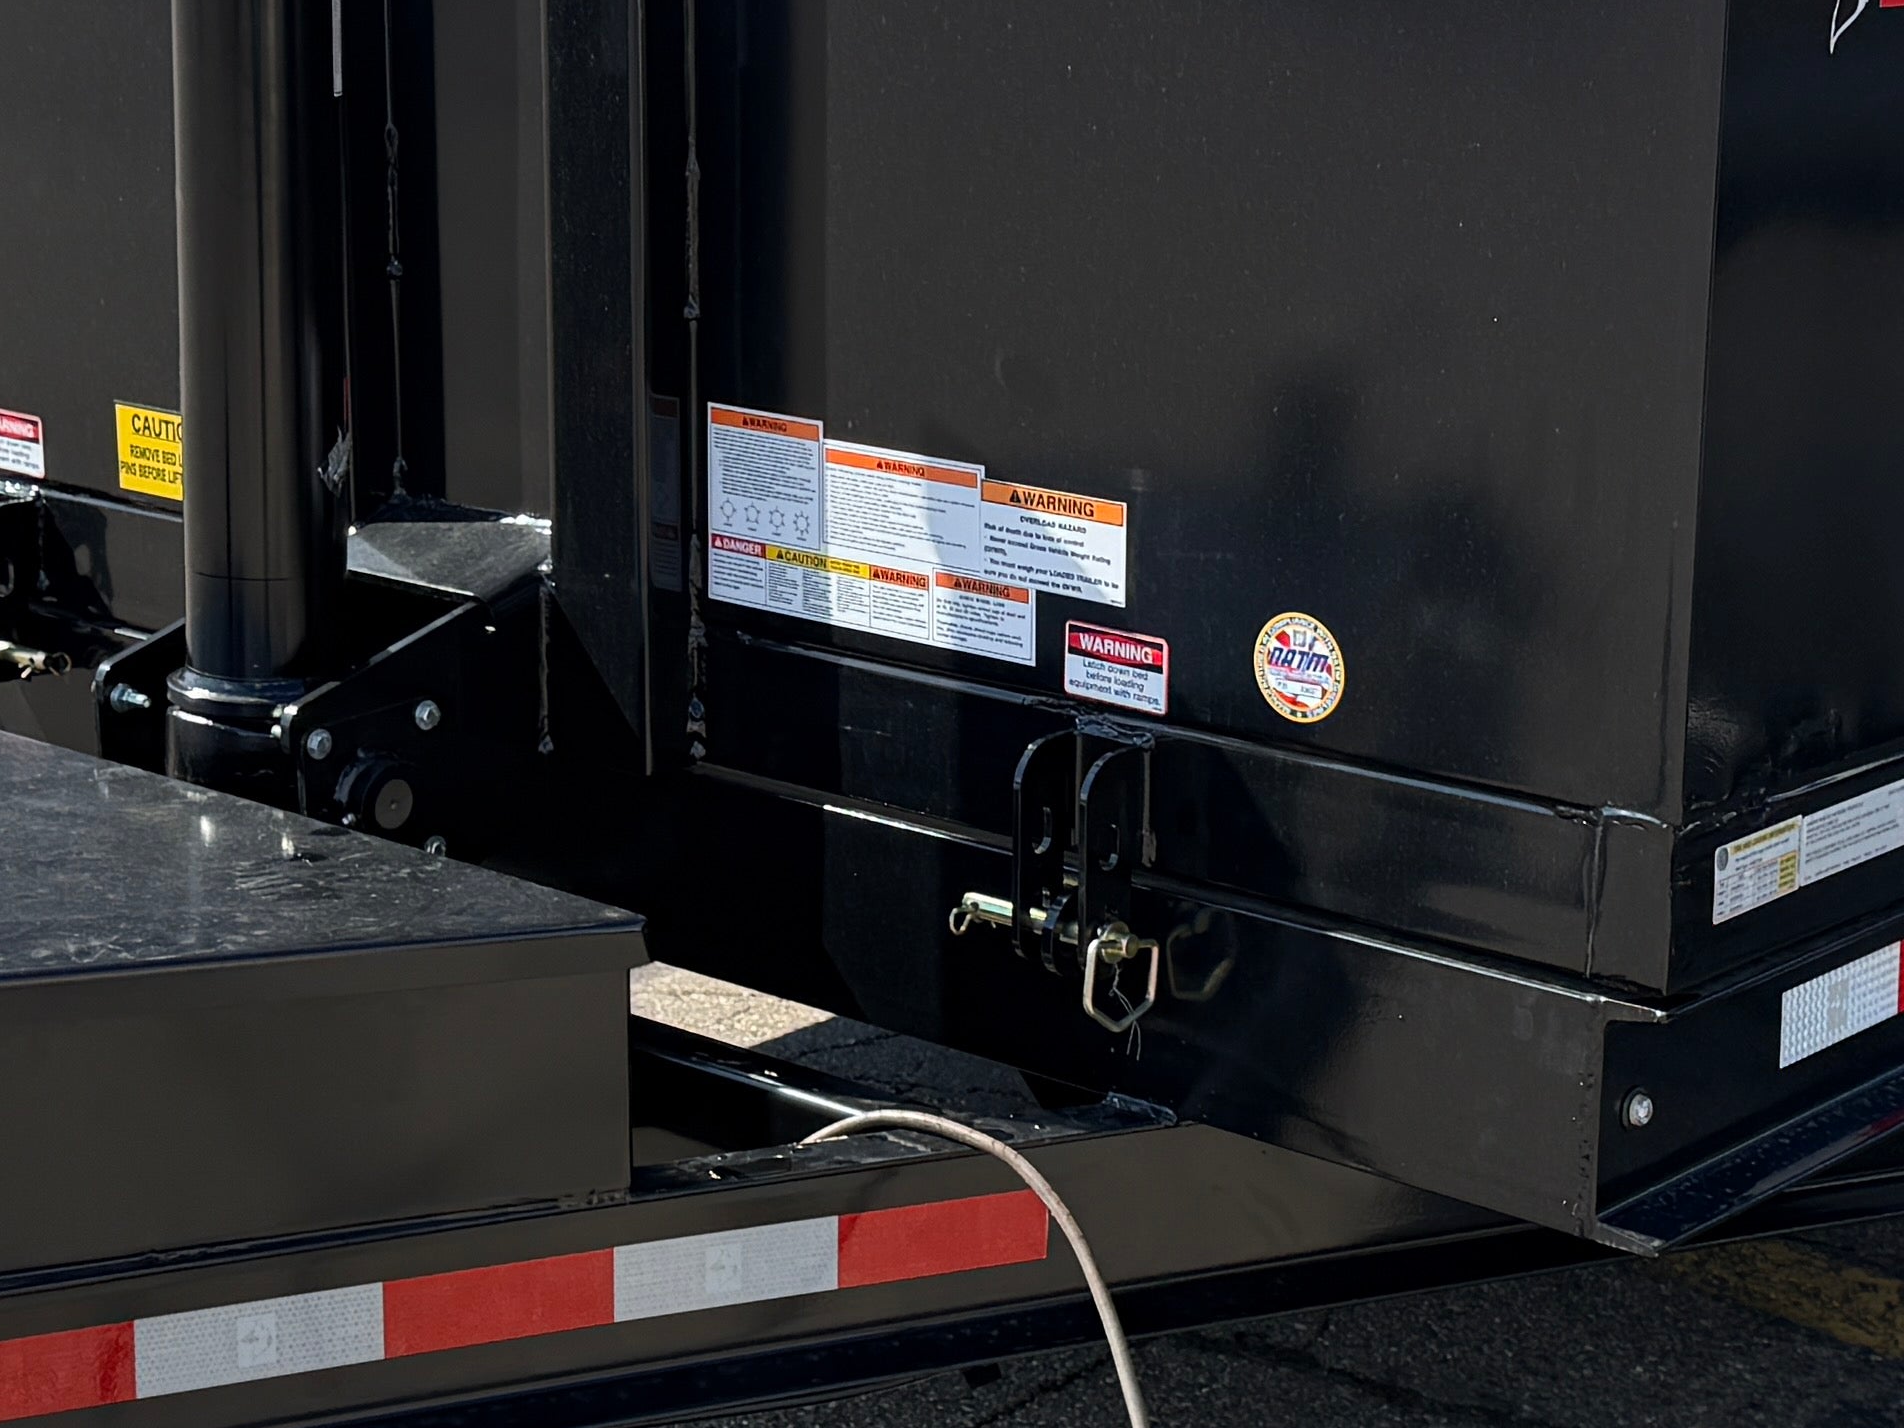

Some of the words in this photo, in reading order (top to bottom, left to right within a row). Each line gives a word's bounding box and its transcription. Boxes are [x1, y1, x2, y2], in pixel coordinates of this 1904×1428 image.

[132, 413, 183, 441] CAUTIO
[748, 416, 787, 432] WARNING
[130, 444, 160, 463] REMOVE
[162, 451, 176, 466] BED
[120, 460, 136, 476] PINS
[139, 464, 167, 482] BEFORE
[883, 461, 925, 477] WARNING
[1022, 490, 1094, 518] WARNING
[722, 538, 763, 556] DANGER
[784, 552, 827, 570] CAUTION
[879, 568, 927, 588] WARNING
[961, 578, 1011, 598] WARNING
[1079, 632, 1153, 664] WARNING
[1082, 658, 1106, 670] Latch
[1107, 664, 1130, 676] down
[1131, 668, 1149, 681] bed
[1069, 678, 1112, 694] equipment
[1113, 688, 1131, 699] with
[1086, 670, 1112, 683] before
[1114, 676, 1145, 693] loading
